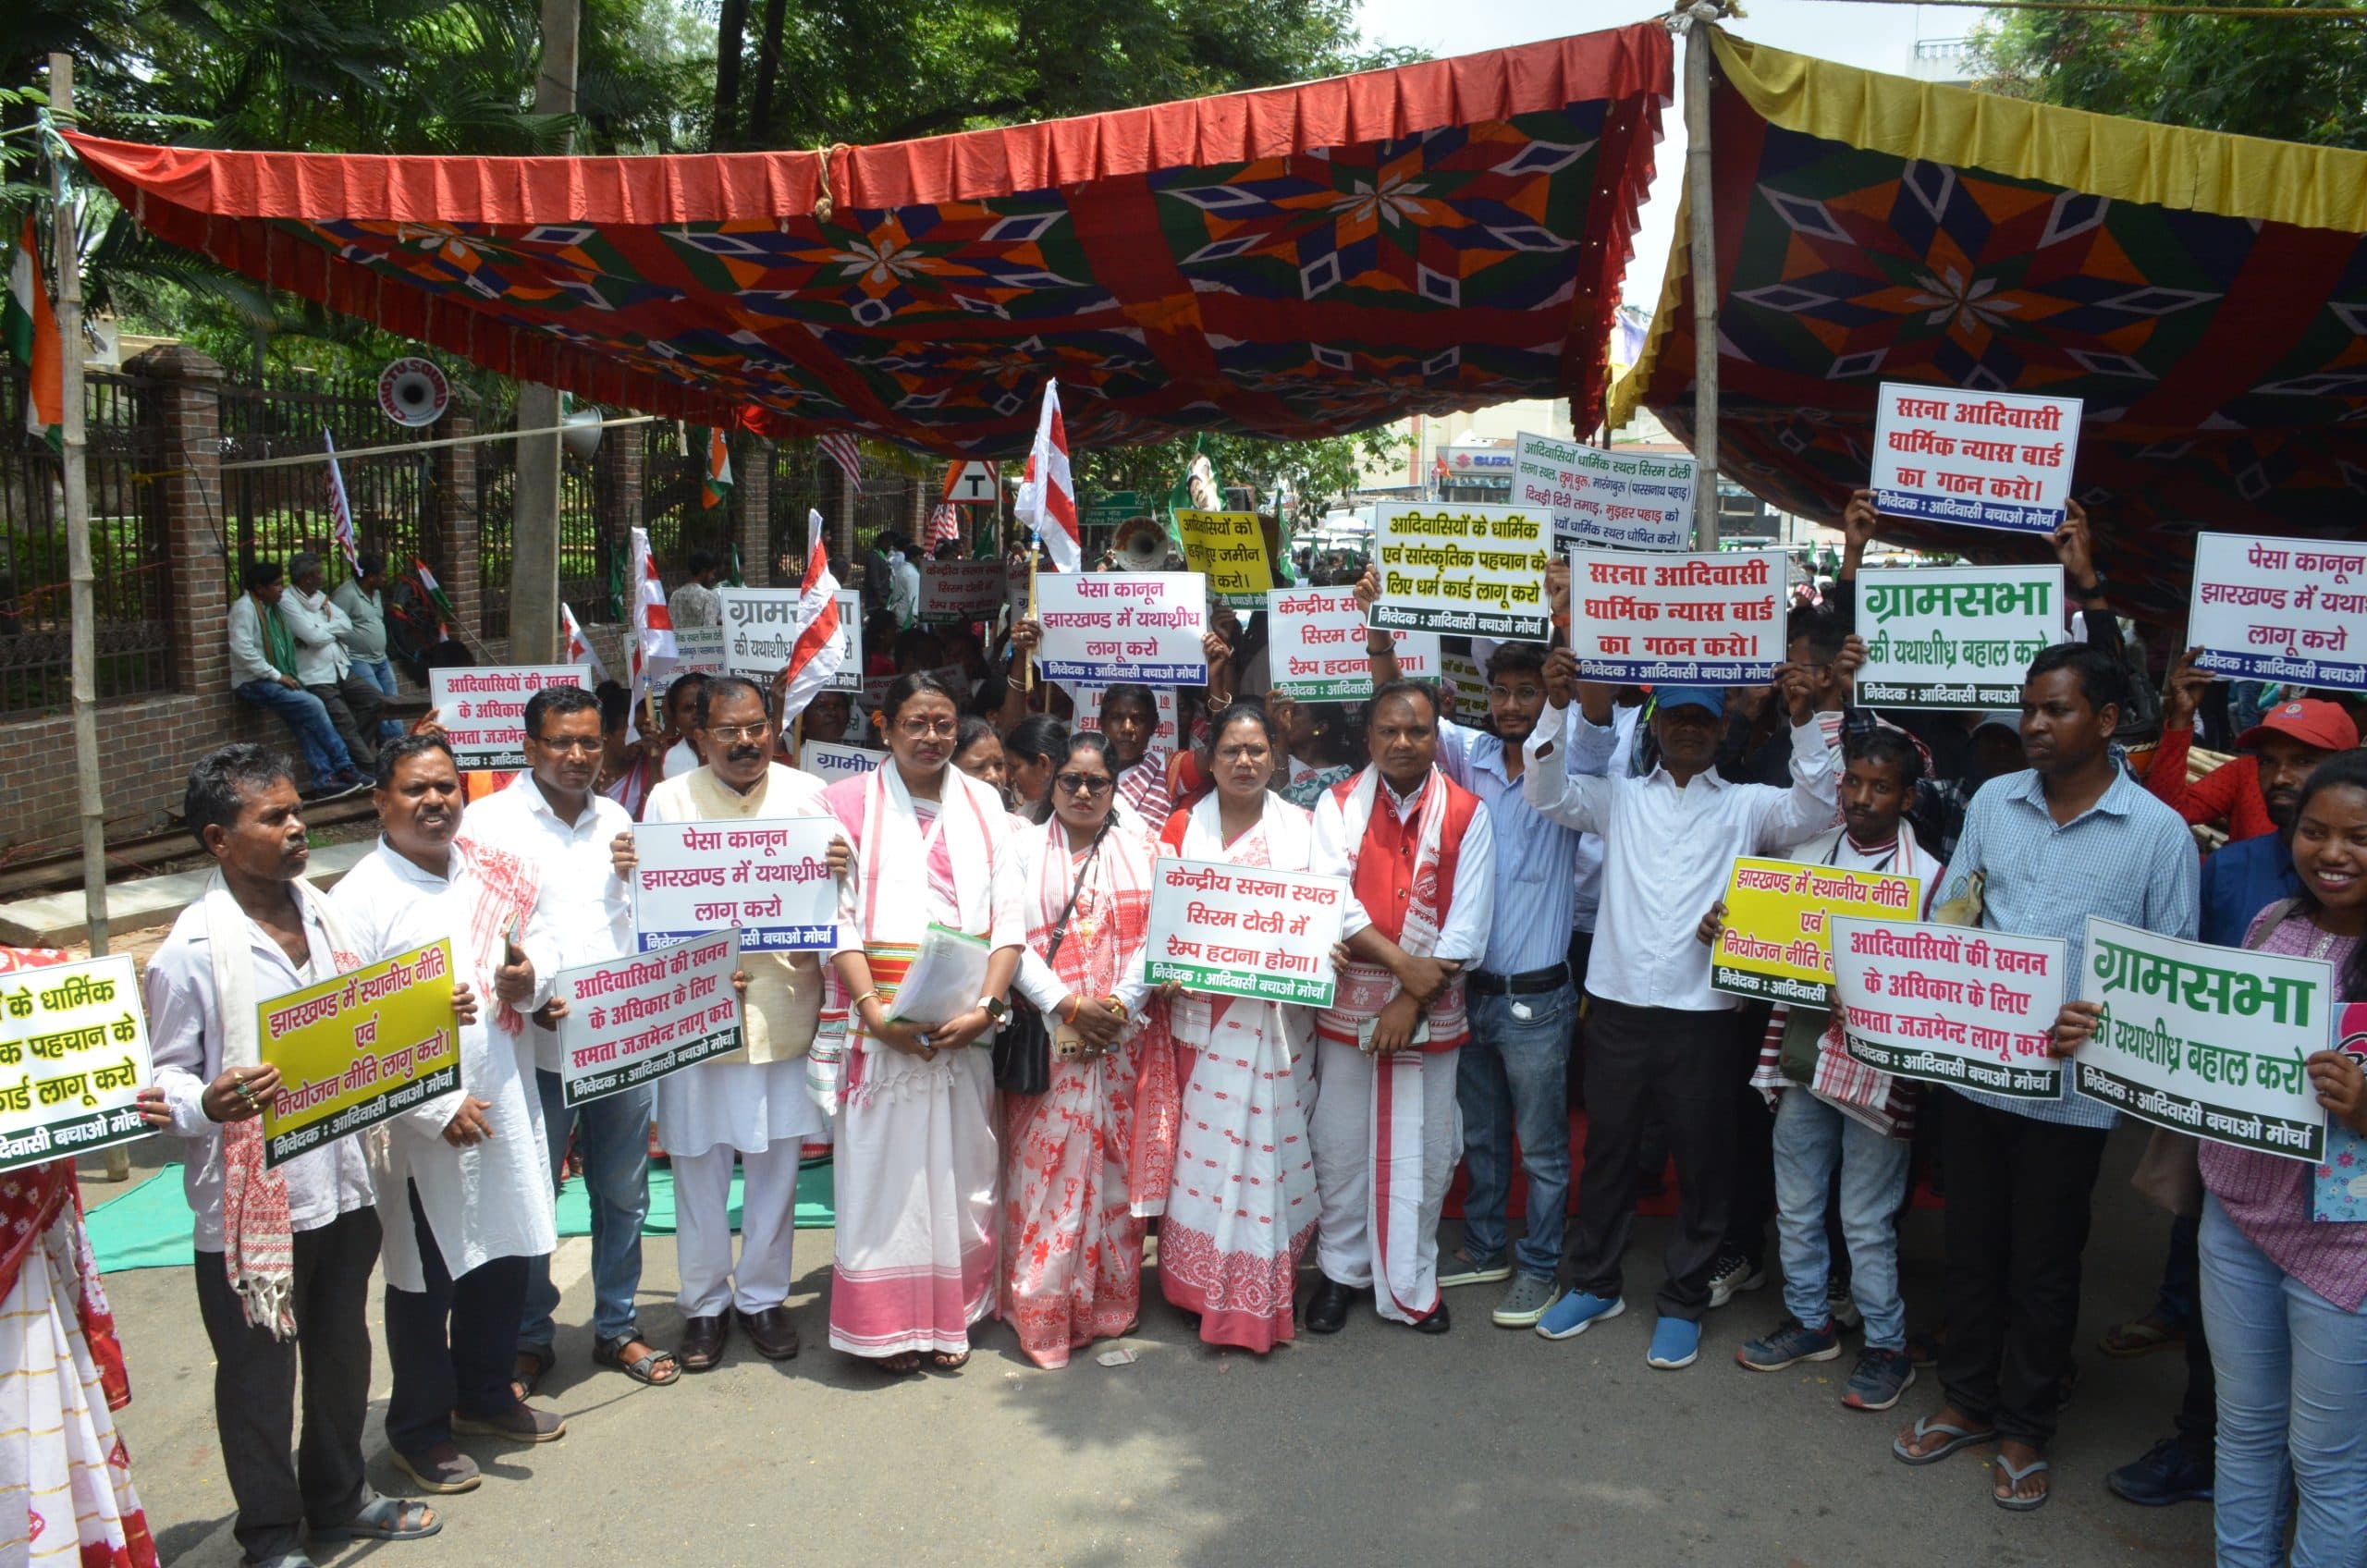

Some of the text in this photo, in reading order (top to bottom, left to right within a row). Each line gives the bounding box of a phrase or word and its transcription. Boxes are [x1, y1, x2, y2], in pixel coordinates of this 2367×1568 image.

[380, 361, 407, 421] CHHOTU
[1896, 398, 2063, 431] सरना आदिवासी
[1525, 441, 1577, 464] आदिवासियों
[1613, 461, 1637, 474] स्थल
[1639, 460, 1666, 476] सिरम
[1669, 463, 1691, 479] टोली
[1961, 440, 2017, 462] न्यास
[1896, 468, 1926, 488] का
[1937, 472, 1985, 495] गठन
[1233, 518, 1253, 534] को
[1391, 512, 1470, 535] आदिवासियों
[1472, 515, 1488, 536] के
[1665, 508, 1679, 521] को
[1603, 527, 1625, 540] स्थल
[1218, 544, 1259, 561] जमीन
[1382, 543, 1404, 563] एवं
[1478, 553, 1527, 570] पहचान
[1531, 549, 1548, 571] के
[2249, 543, 2366, 584] पेसा कानून
[1588, 559, 1770, 586] सरना आदिवासी
[1076, 578, 1164, 605] पेसा कानून
[1387, 571, 1413, 594] लिए
[1417, 574, 1441, 595] धर्म
[1477, 583, 1509, 608] लागू
[1512, 581, 1540, 602] करो
[1866, 582, 2052, 624] ग्रामसभा
[2201, 583, 2318, 609] झारखण्ड में
[1043, 613, 1112, 629] झारखण्ड
[1117, 607, 1134, 627] में
[1279, 594, 1335, 616] केन्द्रीय
[1379, 606, 1542, 634] निवेदक आदिवासी बचाओ मोर्चा
[1665, 603, 1726, 621] न्यास
[733, 632, 748, 656] की
[1301, 625, 1345, 643] सिरम
[1597, 636, 1631, 655] का
[1643, 637, 1697, 655] गठन
[1867, 630, 1890, 664] की
[1962, 641, 2010, 668] बहाल
[2249, 625, 2348, 656] लागू करो
[1086, 636, 1158, 663] लागू करो
[1289, 653, 1372, 675] रैम्प हटाना
[448, 673, 543, 692] आदिवासियों की
[839, 673, 857, 686] मोर्चा
[1049, 661, 1200, 679] निवेदक आदिवासी बचाओ मोर्चा
[1327, 680, 1373, 695] आदिवासी
[458, 701, 472, 718] के
[682, 827, 788, 857] पेसा कानून
[641, 868, 726, 890] झारखण्ड
[731, 860, 752, 883] में
[1166, 866, 1339, 904] केन्द्रीय सरना स्थल
[1736, 868, 1909, 907] झारखण्ड में स्थानीय नीति
[694, 894, 782, 926] लागू करो
[1187, 901, 1310, 936] सिरम टोली में
[1801, 910, 1825, 932] एवं
[1167, 934, 1202, 958] रैम्प
[1207, 945, 1260, 965] हटाना
[1723, 929, 1782, 962] नियोजन
[1785, 940, 1820, 967] नीति
[575, 941, 729, 999] आदिवासियों की खनन
[2094, 938, 2316, 1027] ग्रामसभा
[6, 986, 32, 1016] के
[269, 947, 445, 1039] झारखण्ड में स्थानीय नीति
[588, 1007, 606, 1029] के
[673, 984, 687, 1005] के
[690, 974, 717, 999] लिए
[28, 1025, 106, 1058] पहचान
[111, 1013, 135, 1041] के
[355, 1013, 379, 1048] एवं
[572, 1041, 617, 1068] समता
[677, 1011, 707, 1035] लागू
[707, 998, 733, 1023] करो
[36, 1057, 136, 1106] लागू करो
[2188, 1041, 2250, 1086] बहाल
[2256, 1046, 2307, 1095] करो
[273, 1076, 340, 1119] नियोजन
[343, 1054, 378, 1090] नीति
